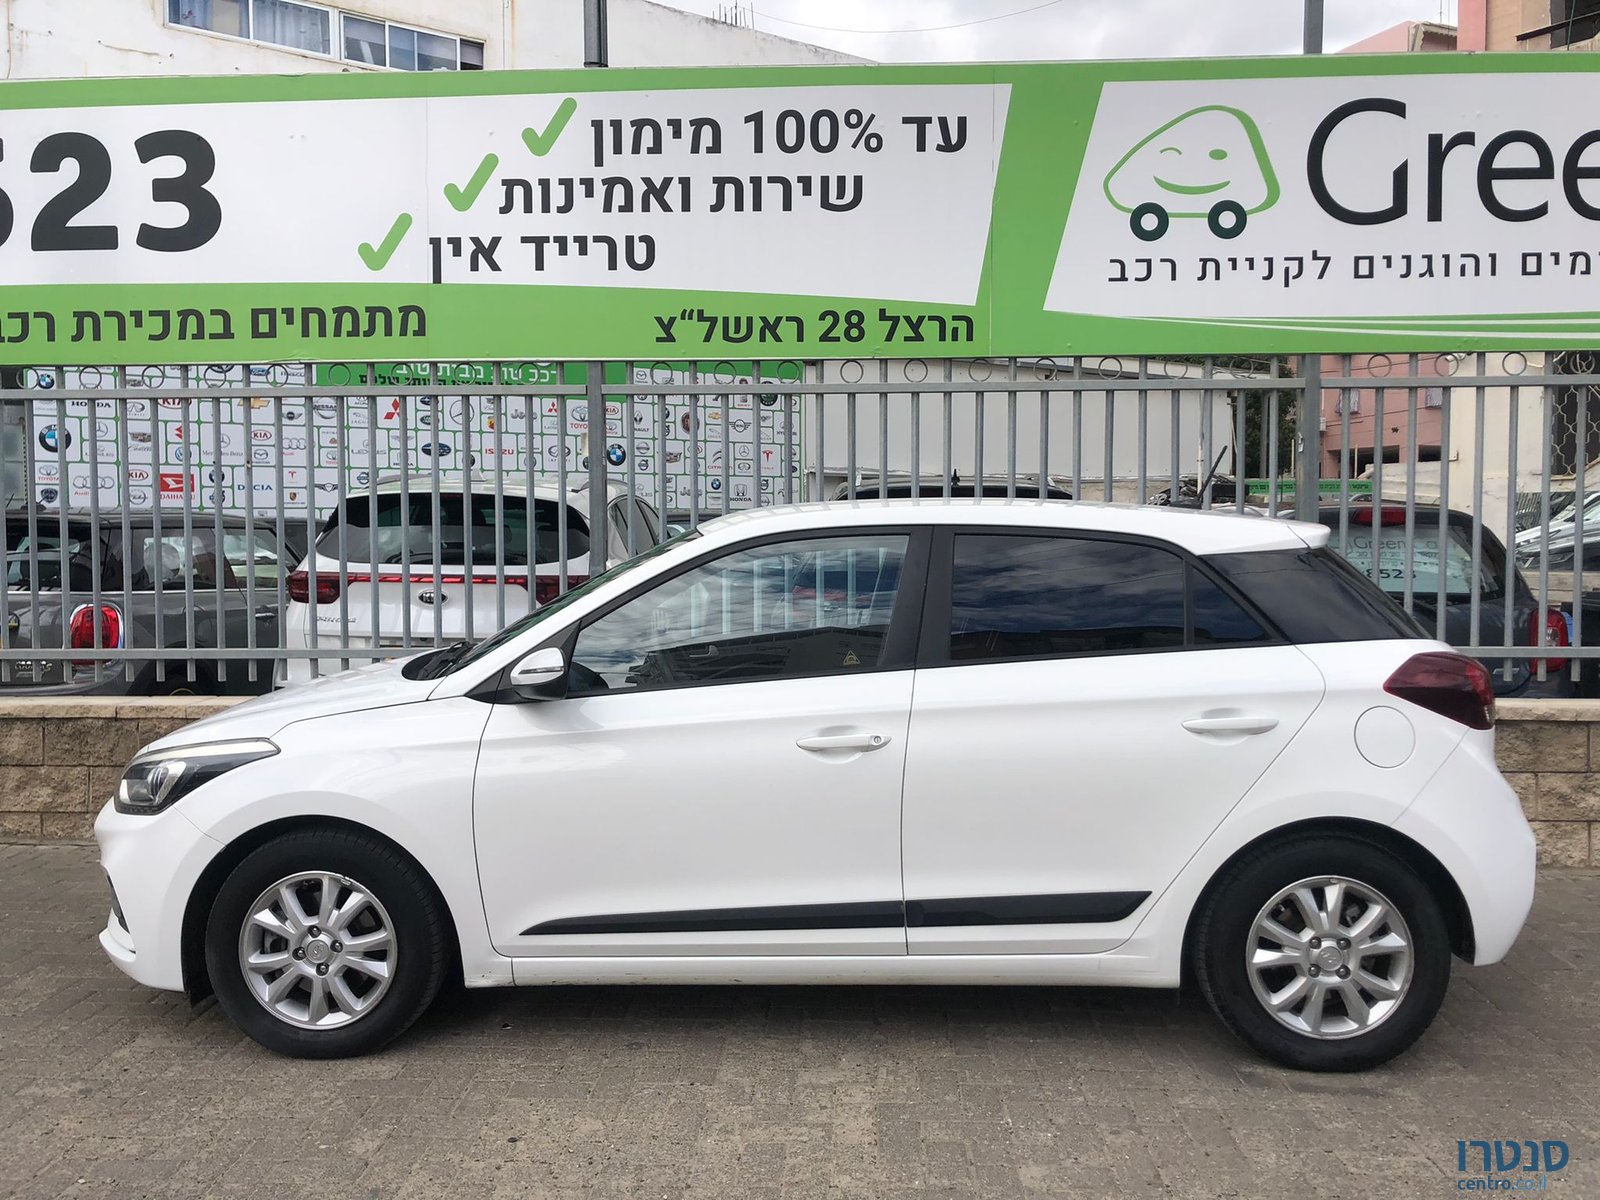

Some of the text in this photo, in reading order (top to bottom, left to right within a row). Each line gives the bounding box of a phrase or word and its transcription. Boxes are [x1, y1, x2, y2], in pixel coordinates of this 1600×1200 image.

[590, 108, 967, 168] עד 100% מימון
[0, 129, 223, 253] 23
[499, 174, 864, 215] שירות ואמינות
[429, 234, 656, 285] טרייד אין
[1108, 258, 1177, 283] רכב
[1197, 249, 1332, 288] לקניית
[1353, 252, 1497, 280] והוגנים
[0, 304, 426, 343] מתמחים במכירת רכ
[818, 308, 867, 344] 28
[878, 307, 975, 344] הרצל
[71, 400, 112, 408] HODA
